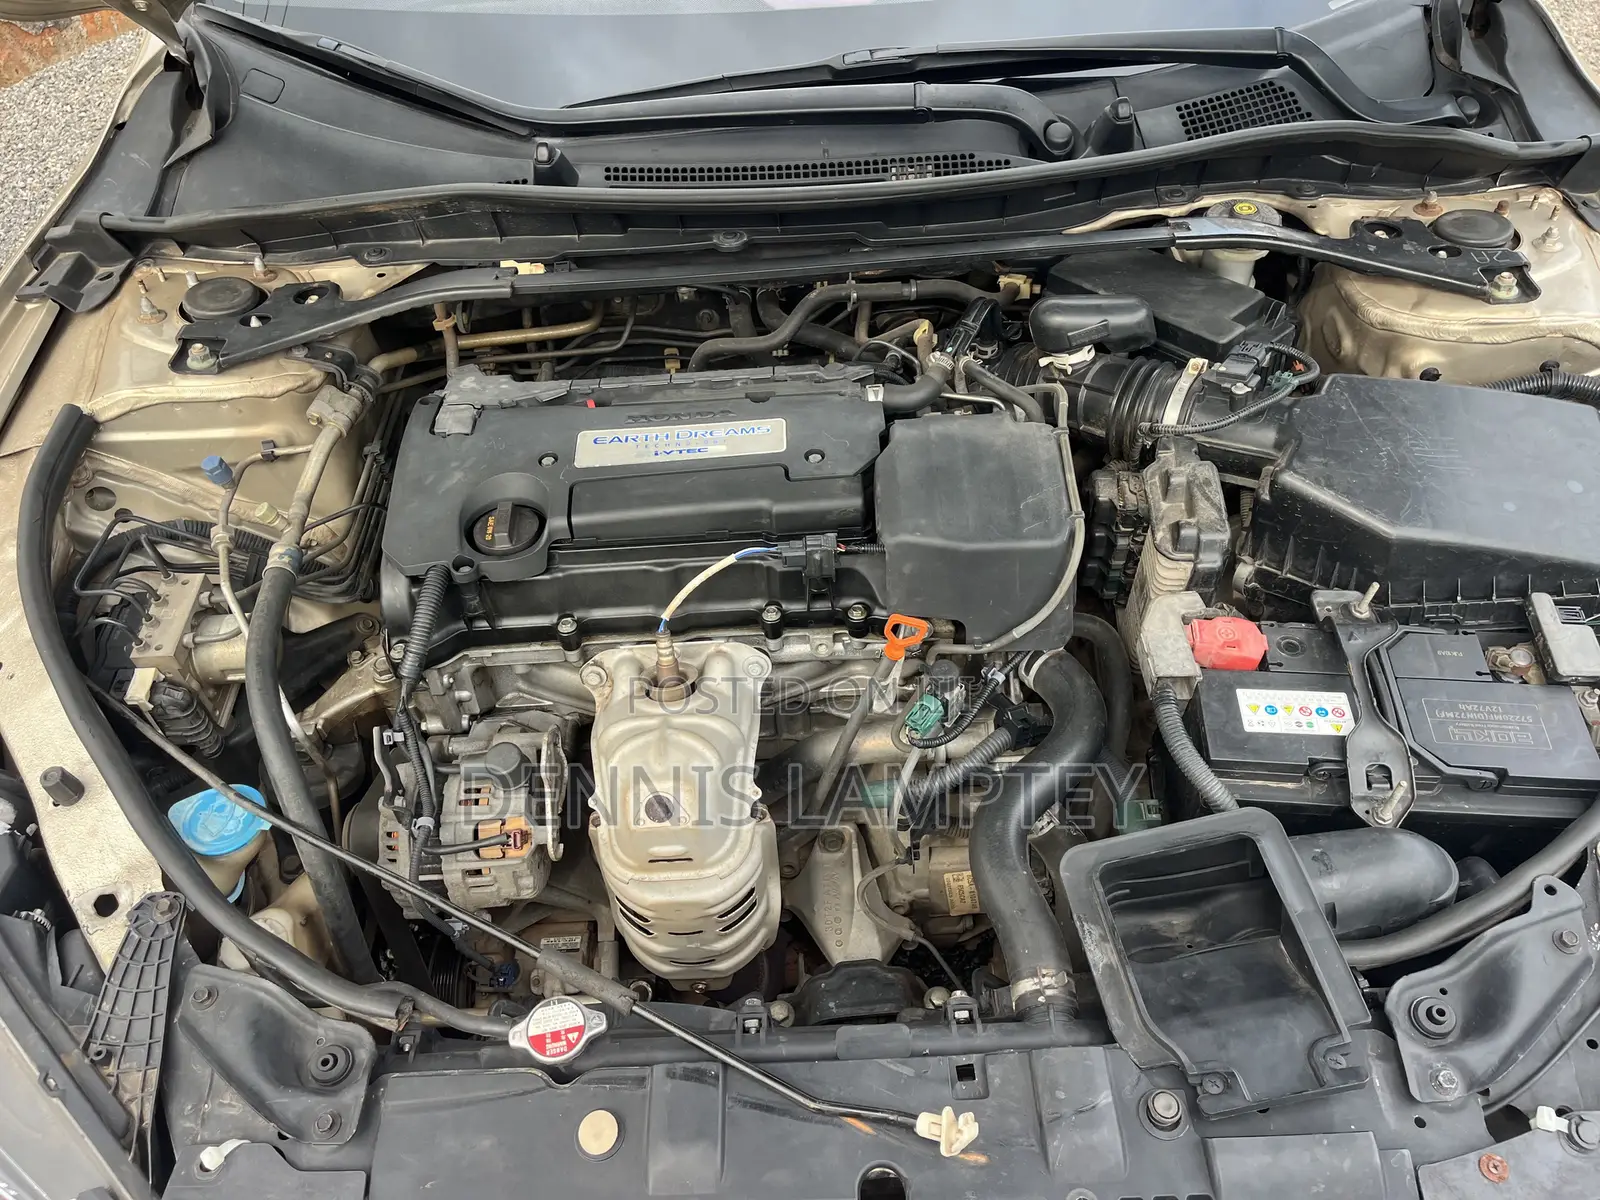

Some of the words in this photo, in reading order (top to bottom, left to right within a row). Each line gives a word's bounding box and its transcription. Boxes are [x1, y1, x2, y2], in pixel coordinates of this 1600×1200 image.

[624, 409, 737, 425] HONDA
[592, 431, 669, 445] EARTH
[675, 425, 771, 441] DREAMS
